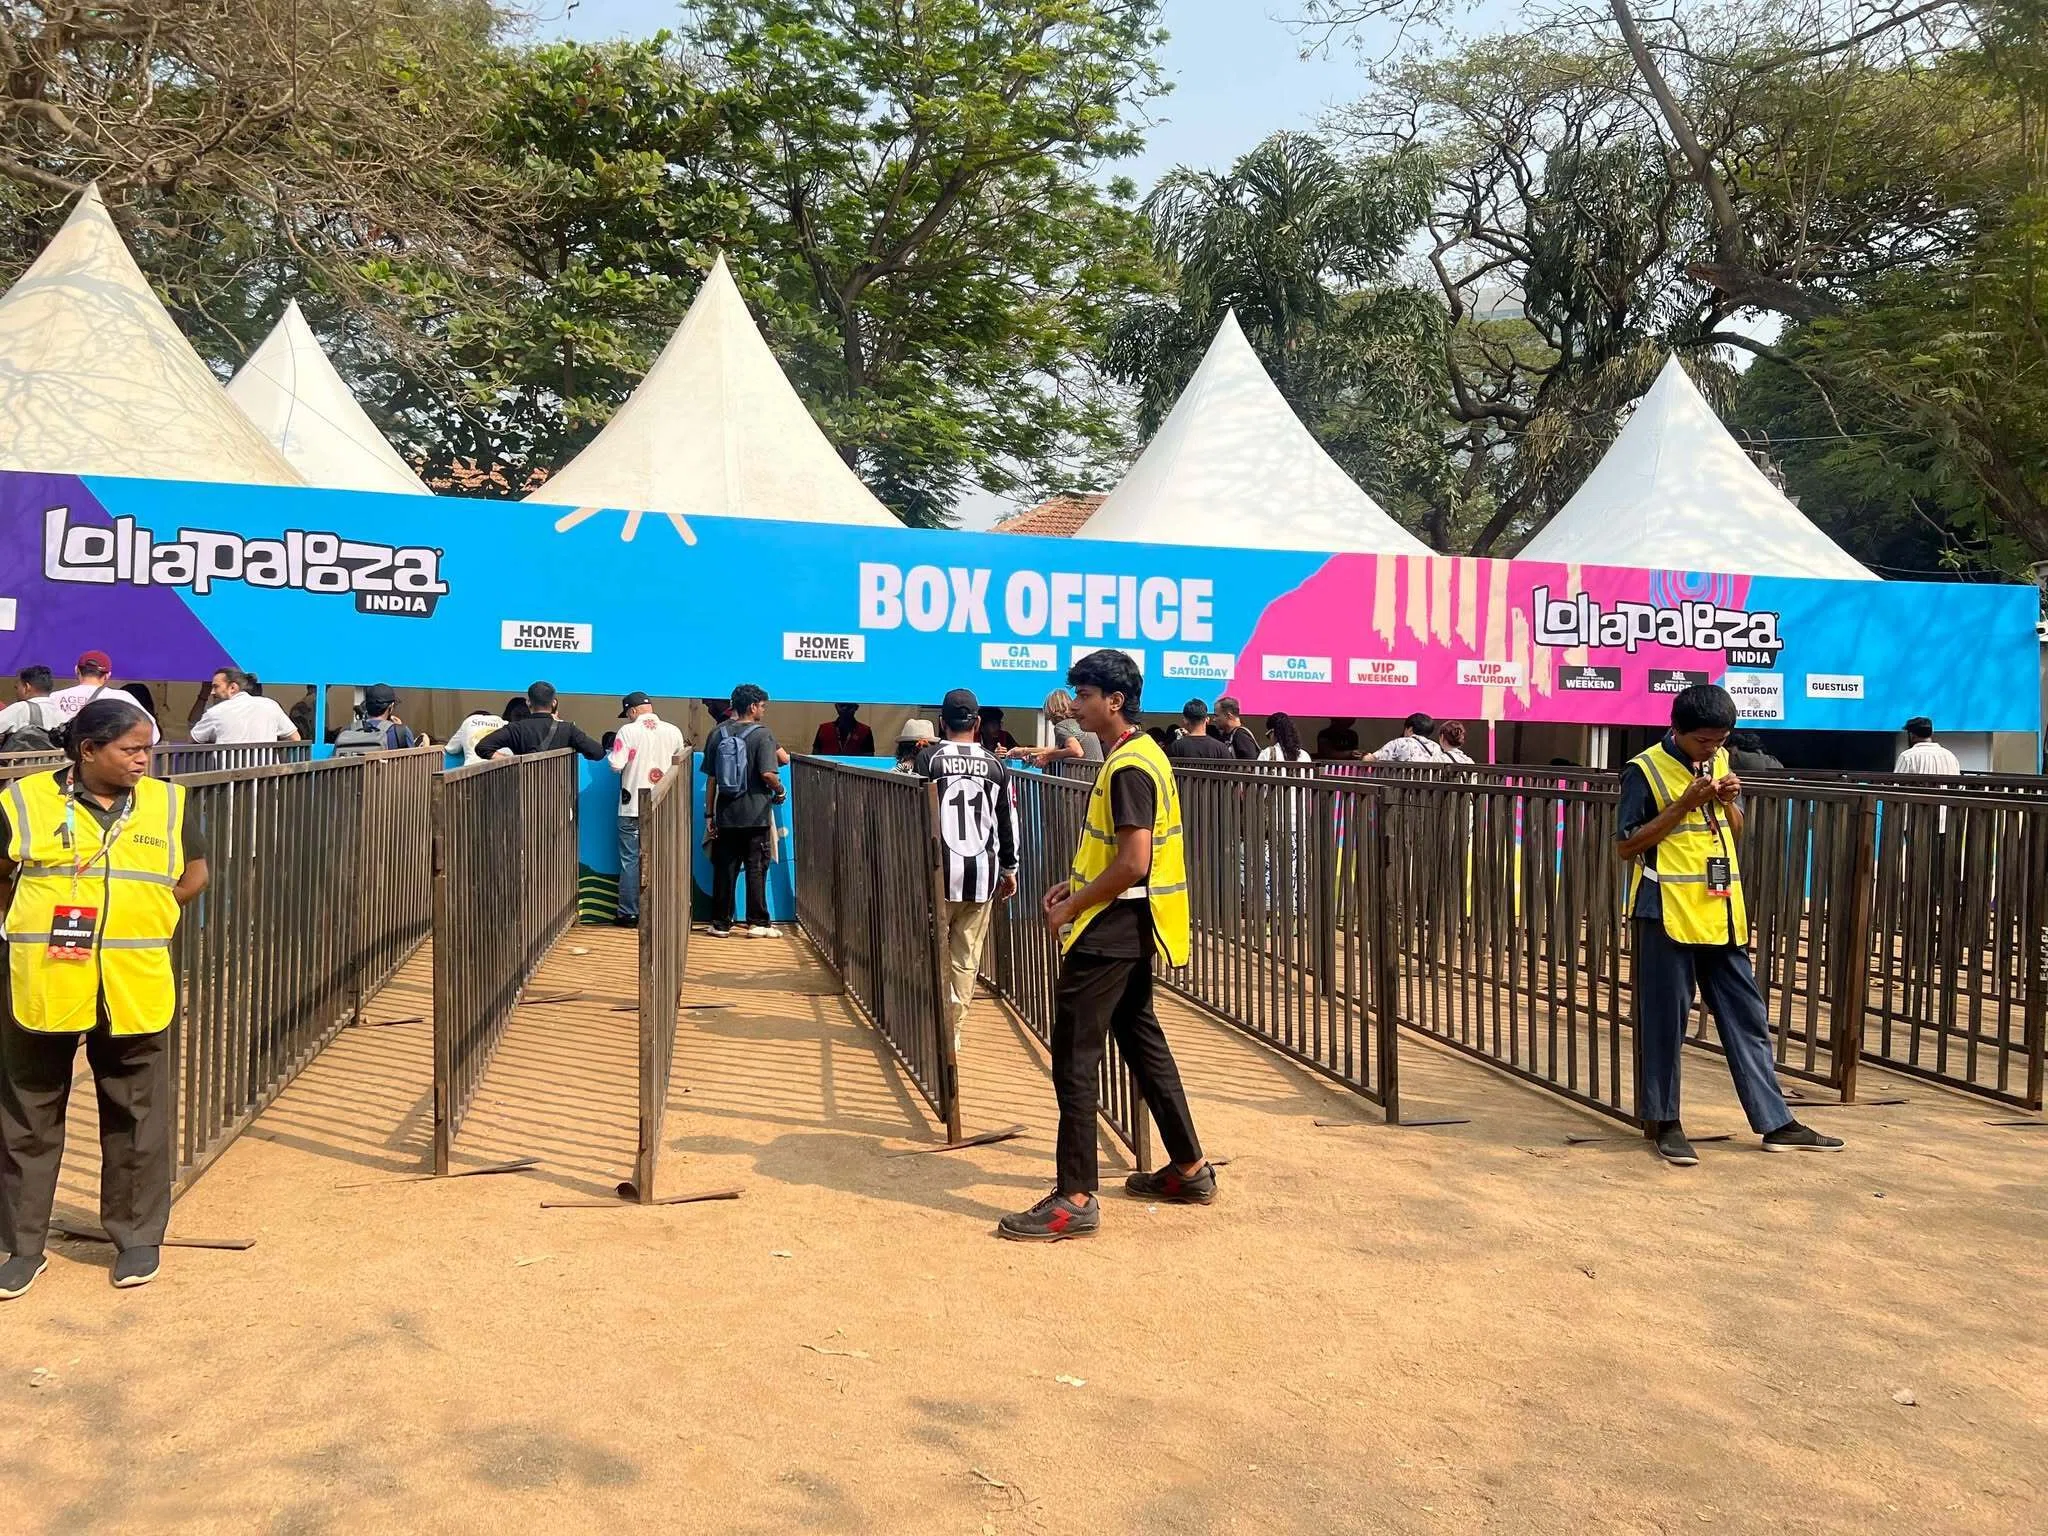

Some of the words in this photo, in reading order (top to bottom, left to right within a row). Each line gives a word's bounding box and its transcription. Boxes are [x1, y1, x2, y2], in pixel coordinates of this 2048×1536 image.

[45, 506, 449, 594] Lollapalooza
[366, 594, 427, 612] INDIA
[859, 562, 991, 634] BOX
[1005, 570, 1213, 642] OFFICE
[1534, 586, 1783, 652] Lollapalooza
[519, 624, 575, 639] HOME
[514, 638, 579, 650] DELIVERY
[799, 636, 849, 649] HOME
[795, 649, 854, 660] DELIVERY
[1008, 646, 1030, 657] GA
[1188, 654, 1210, 666] GA
[1732, 651, 1771, 664] INDIA
[991, 658, 1048, 669] WEEKEND
[1286, 658, 1307, 669] GA
[1371, 662, 1395, 673] VIP
[1478, 663, 1501, 674] VIP
[1169, 666, 1229, 678] SATURDAY
[1268, 670, 1325, 681] SATURDAY
[1357, 673, 1409, 683] WEEKEND
[1463, 674, 1517, 685] SATURDAY
[1565, 679, 1615, 689] WEEKEND
[1812, 682, 1859, 692] GUESTLIST
[1730, 686, 1778, 695] SATURDAY
[943, 758, 989, 776] NEDVED
[949, 789, 983, 841] 11
